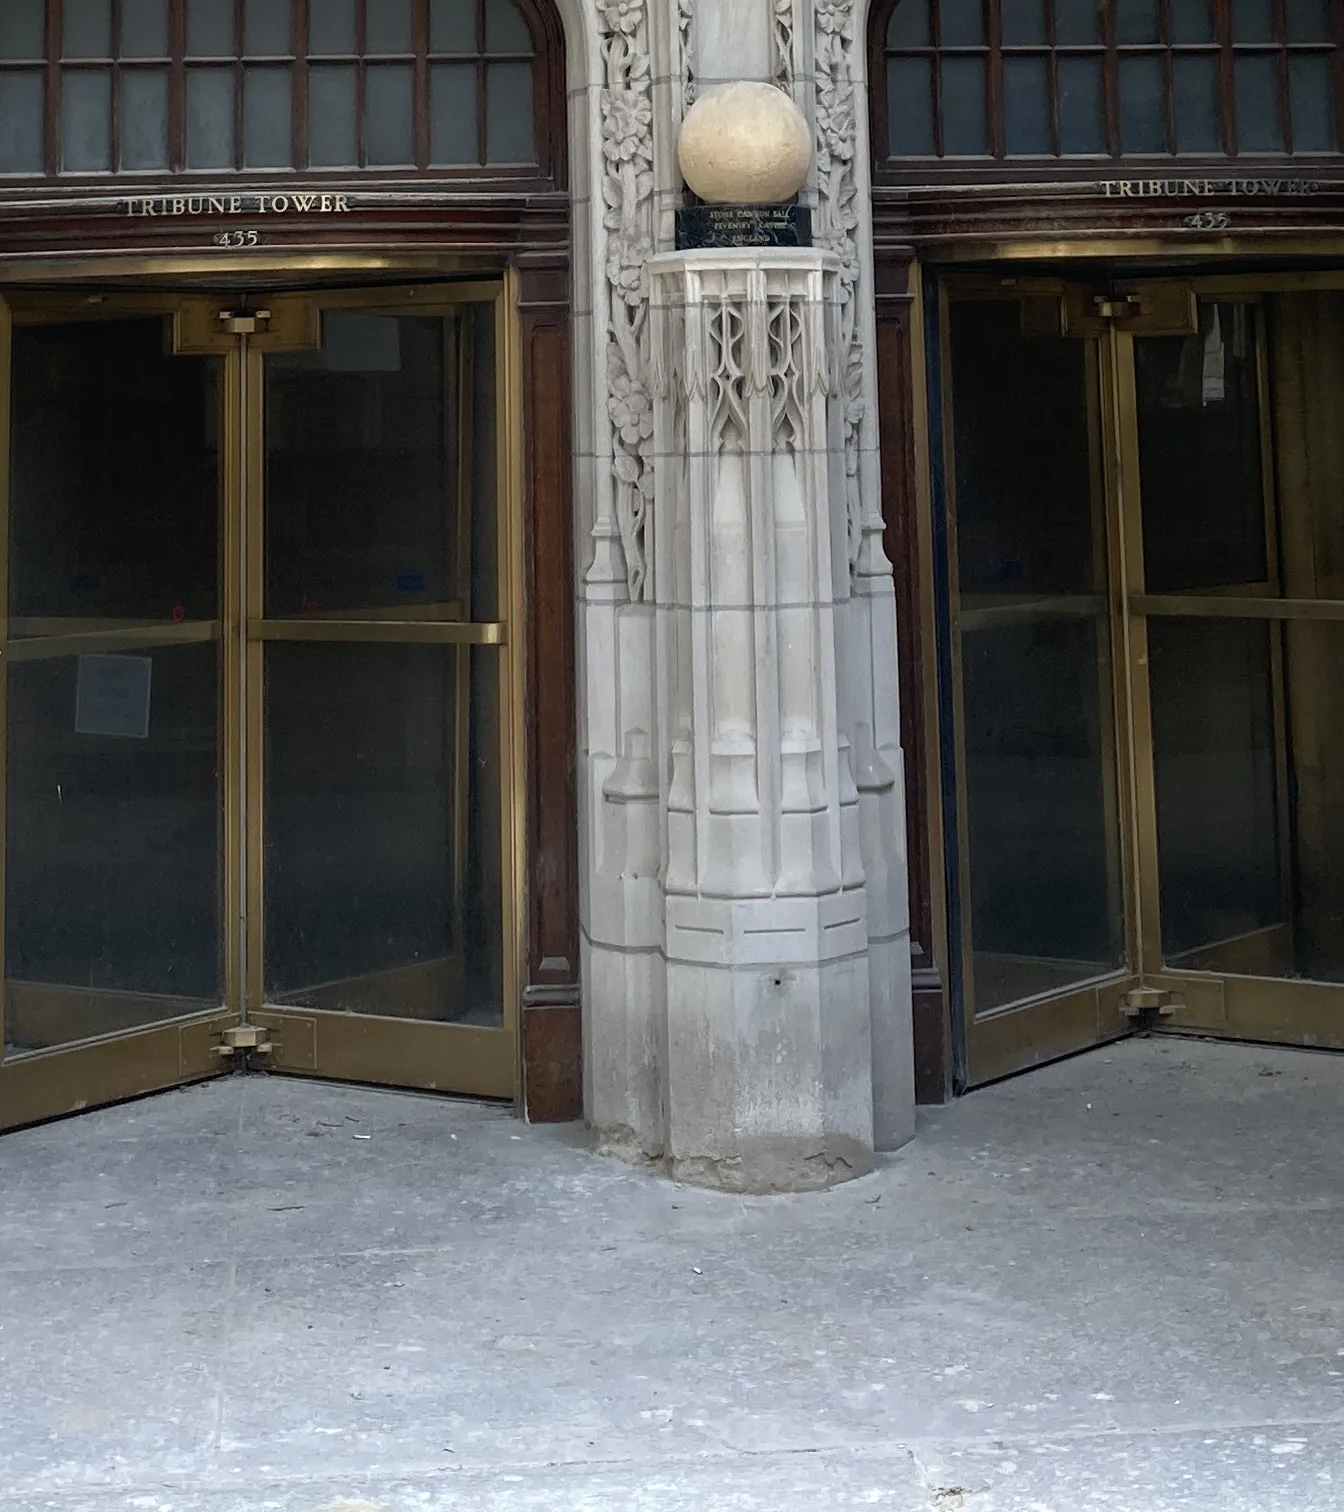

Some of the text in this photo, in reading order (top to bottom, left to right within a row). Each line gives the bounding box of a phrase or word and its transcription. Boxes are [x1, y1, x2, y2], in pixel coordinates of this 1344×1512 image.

[1100, 179, 1313, 197] TRIBUNE TOWER
[125, 194, 351, 217] TRIBUNE TOWER
[1190, 213, 1229, 230] 435
[219, 231, 258, 248] 435
